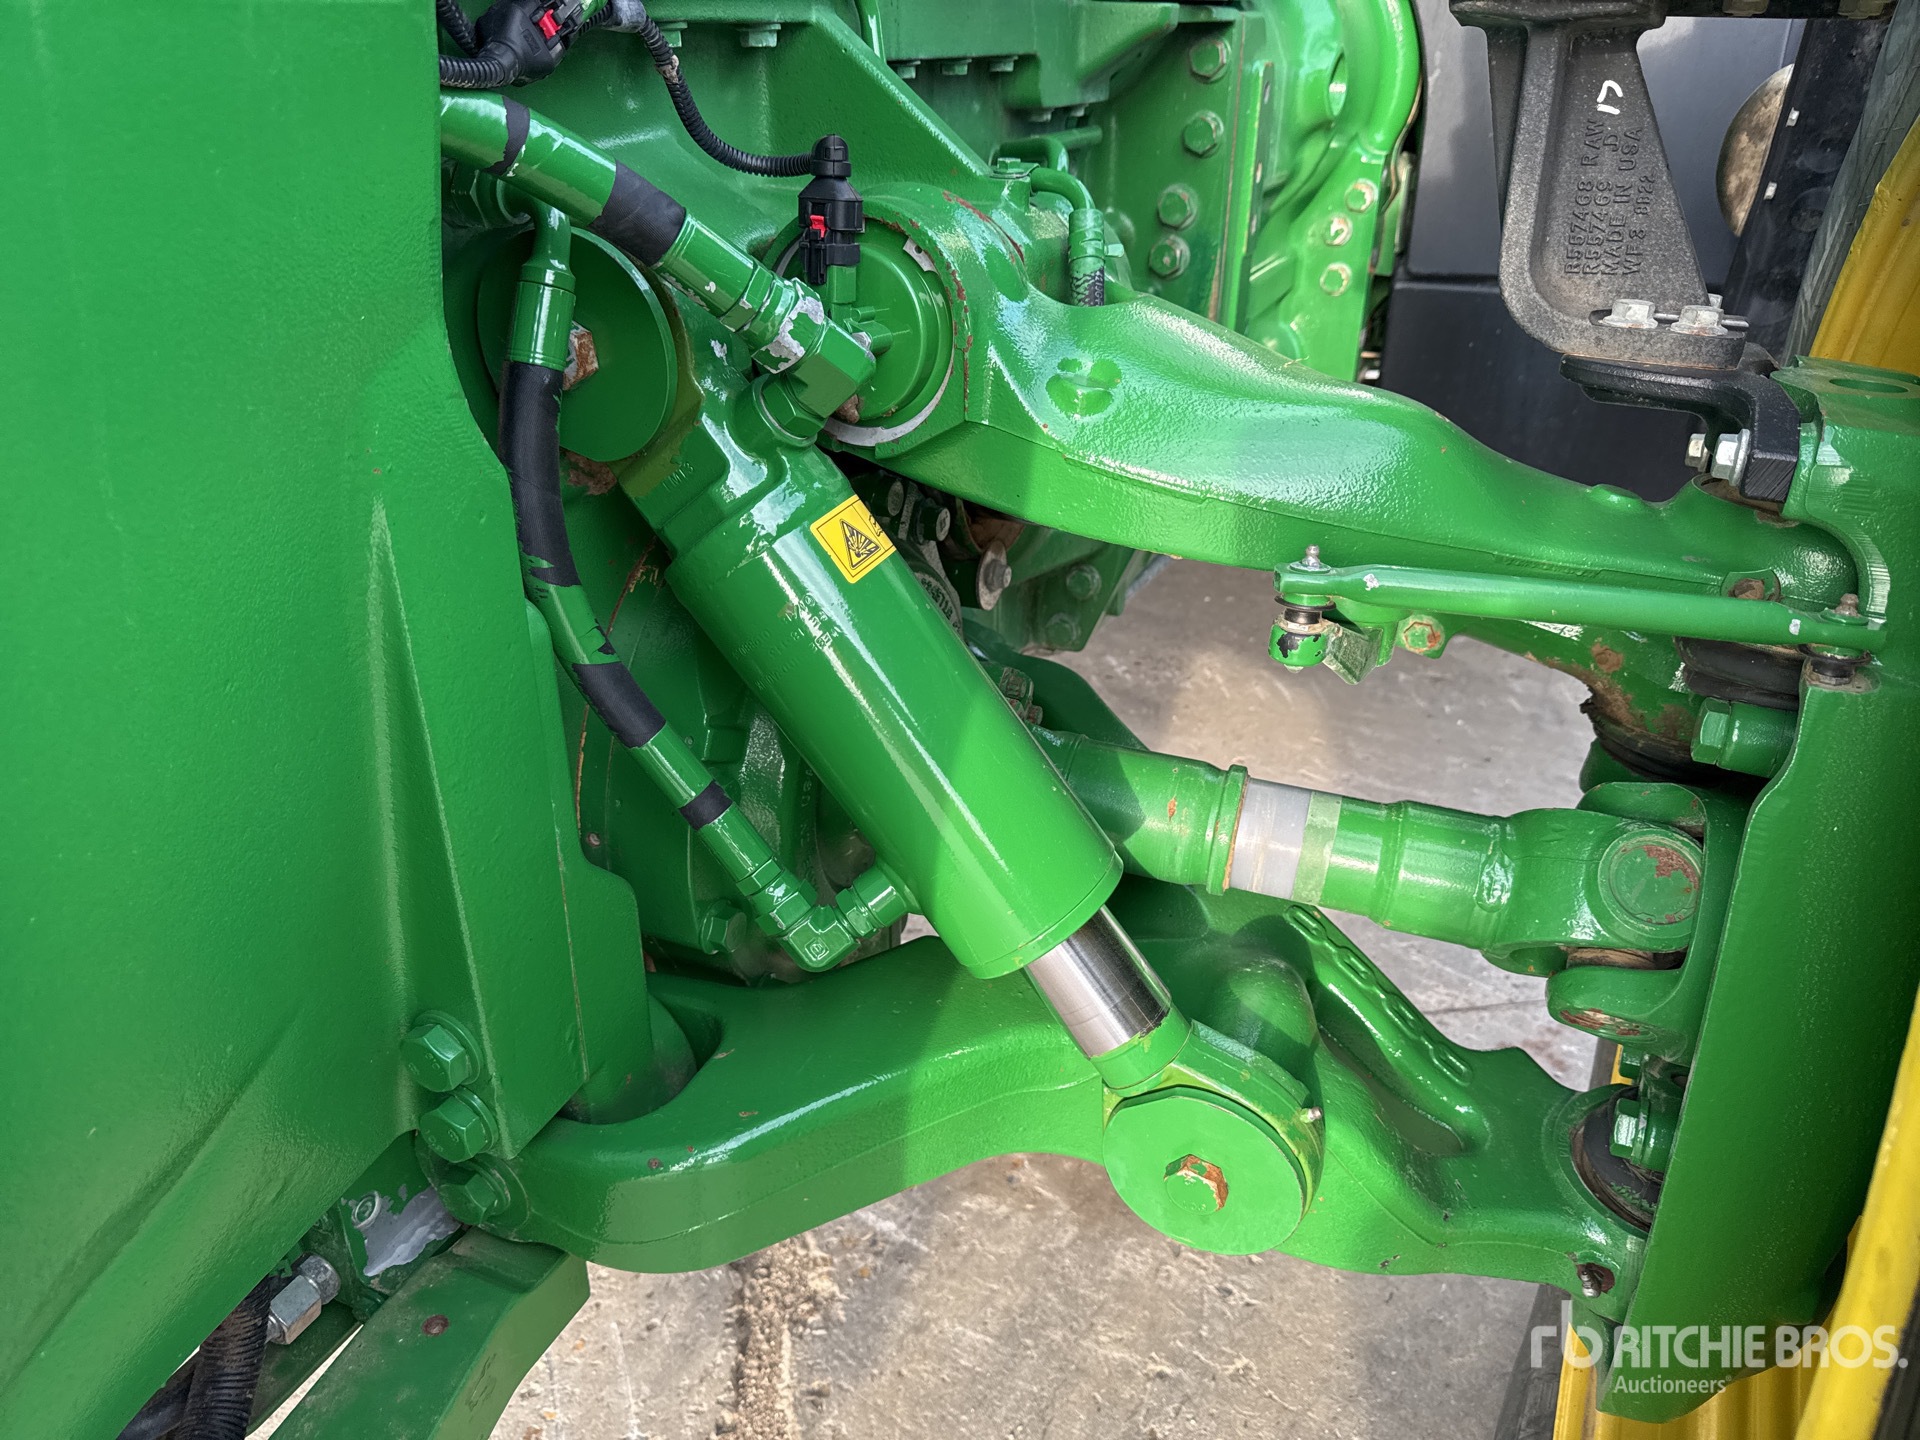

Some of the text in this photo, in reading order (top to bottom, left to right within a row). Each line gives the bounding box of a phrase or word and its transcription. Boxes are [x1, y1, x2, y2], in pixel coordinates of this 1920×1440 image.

[1564, 119, 1604, 274] R557468 RAW
[1582, 180, 1612, 275] R557469
[1600, 128, 1642, 276] MADE IN USA
